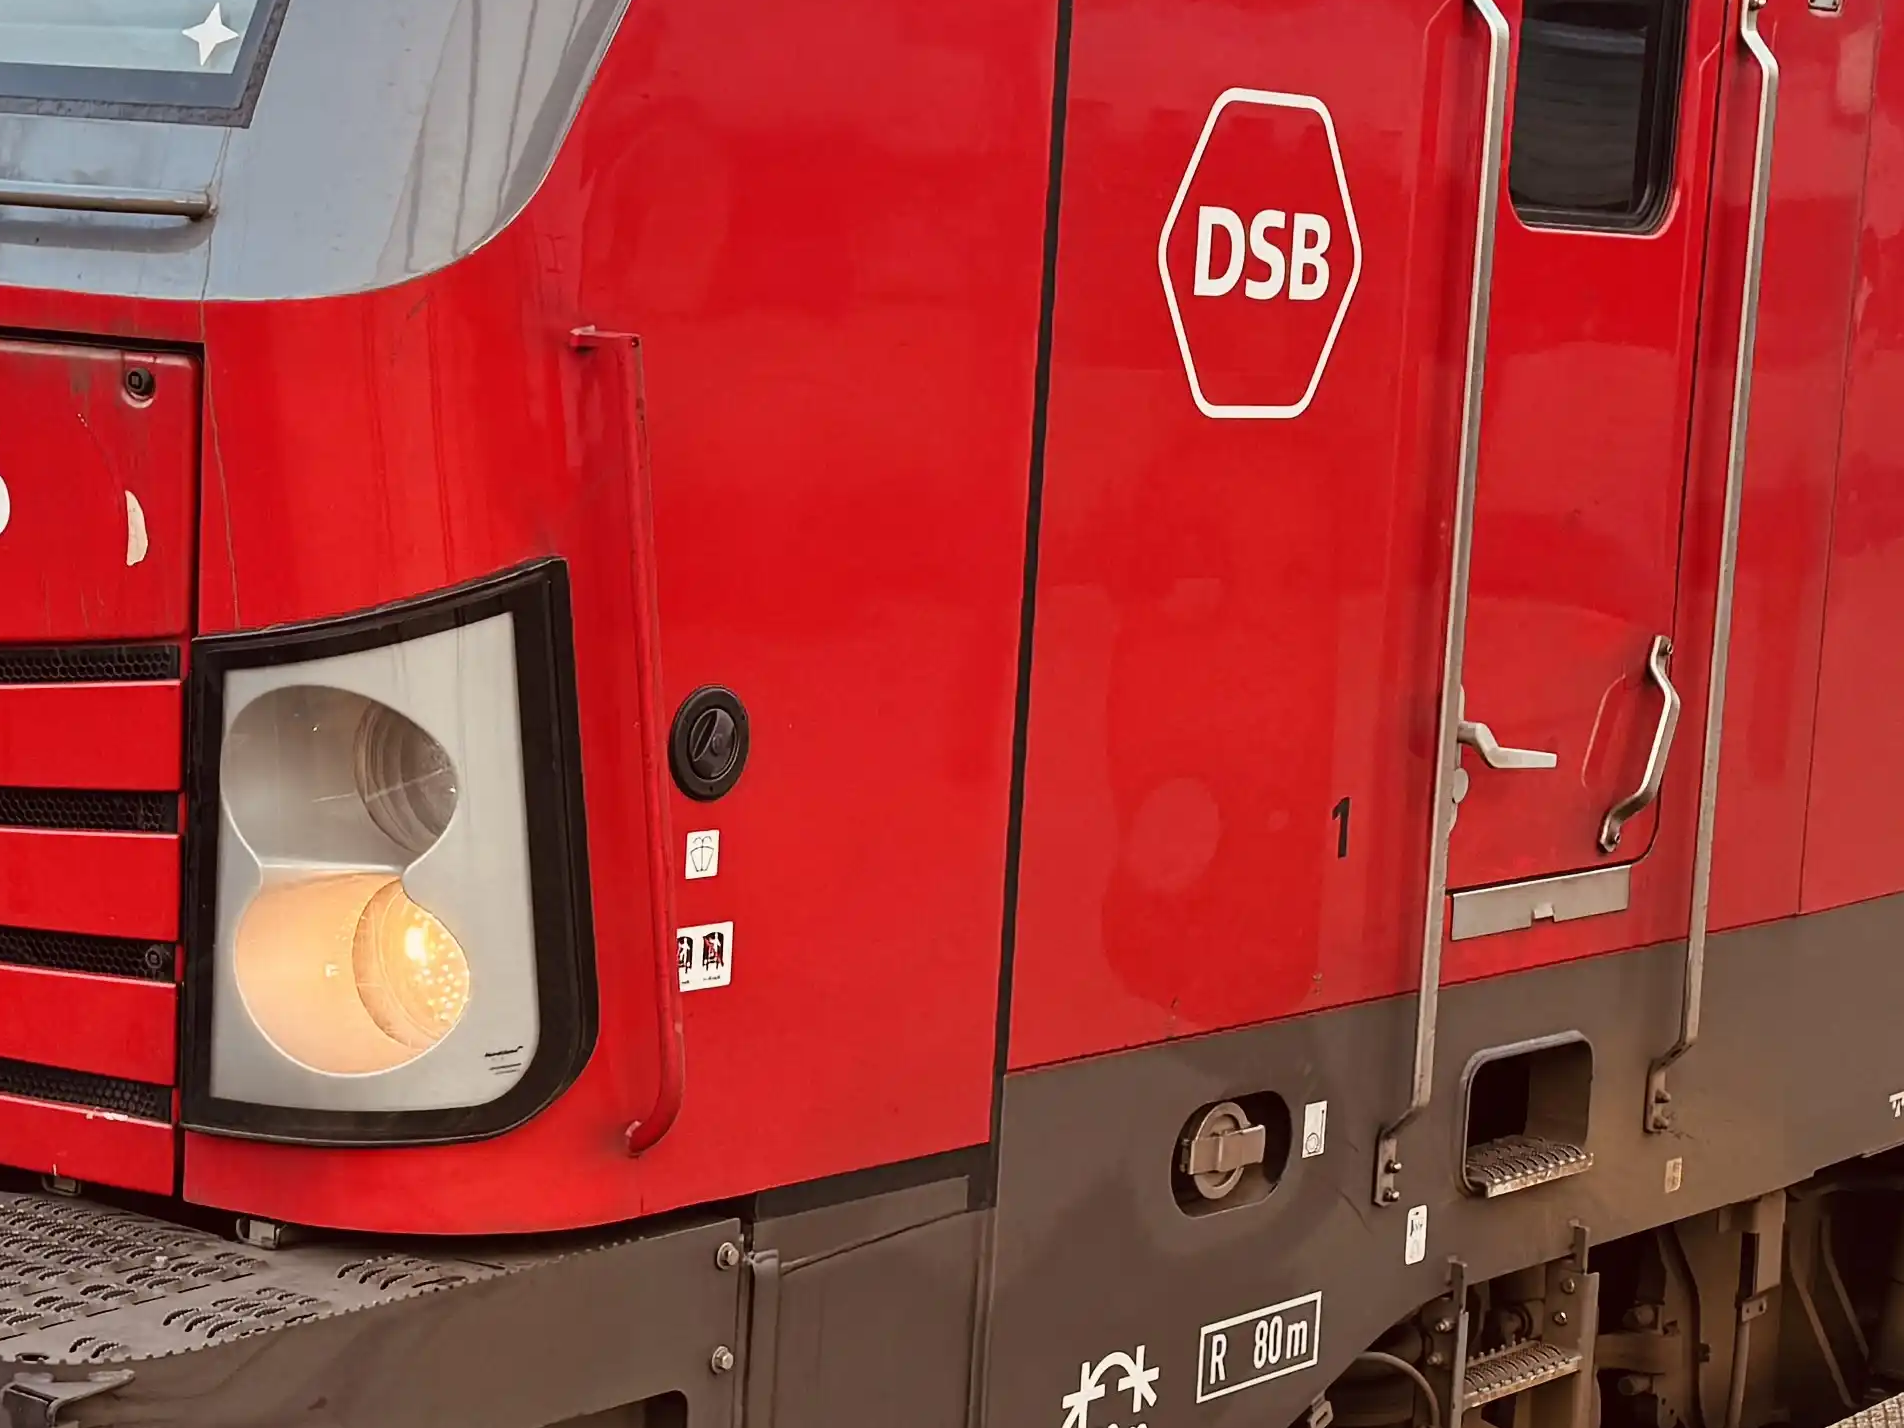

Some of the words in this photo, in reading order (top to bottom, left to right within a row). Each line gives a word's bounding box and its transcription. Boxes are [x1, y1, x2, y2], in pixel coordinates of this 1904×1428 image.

[1193, 205, 1332, 301] DSB
[1331, 797, 1352, 859] 1
[1209, 1333, 1228, 1385] R
